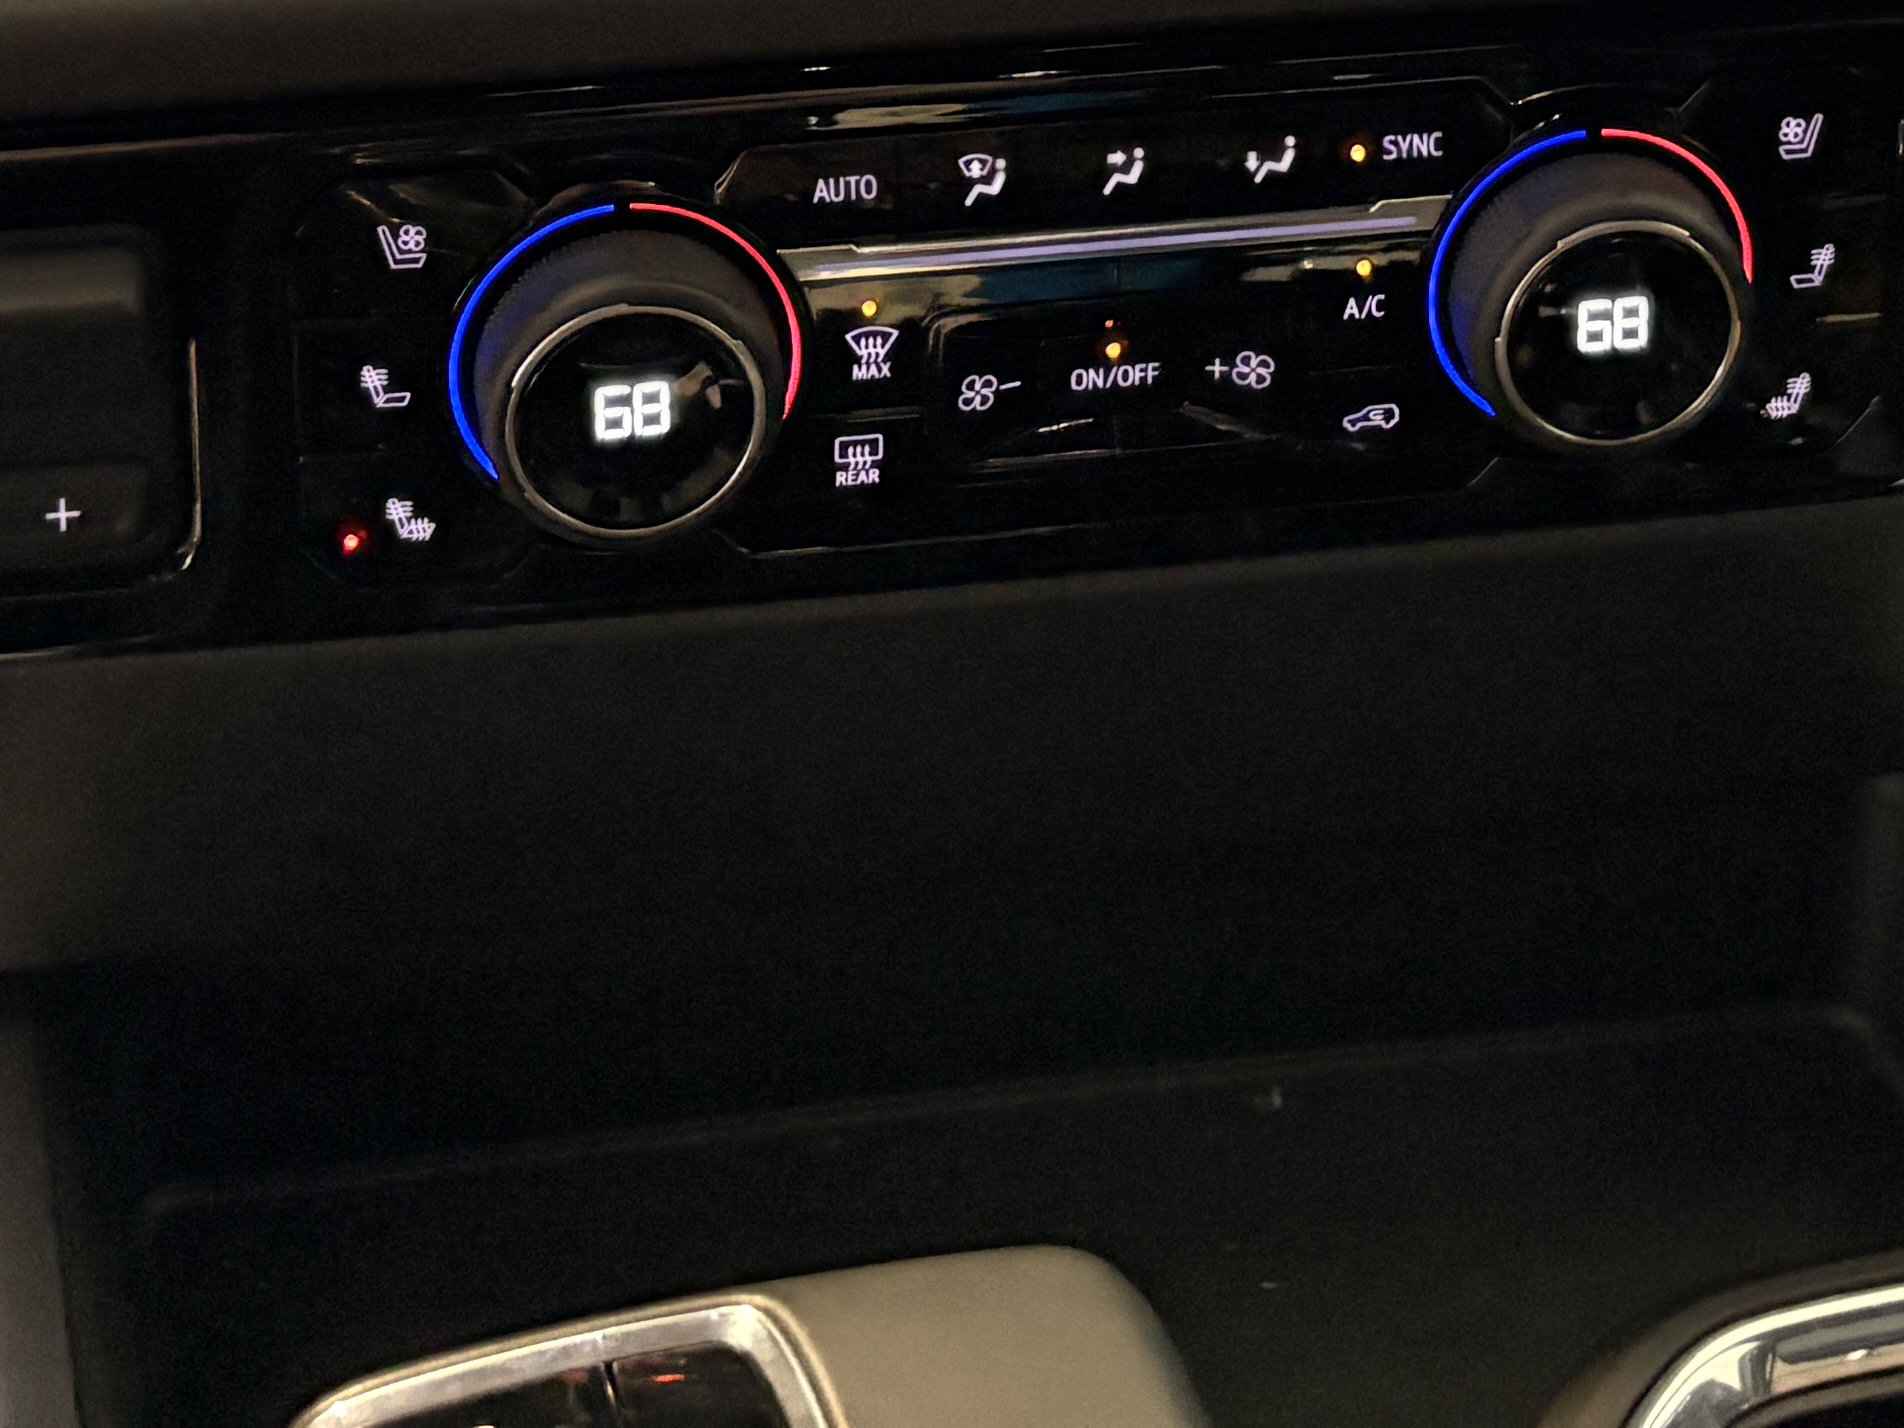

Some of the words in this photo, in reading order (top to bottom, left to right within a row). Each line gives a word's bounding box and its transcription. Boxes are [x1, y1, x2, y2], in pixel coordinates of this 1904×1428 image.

[1382, 133, 1443, 159] SYNC
[812, 175, 878, 204] AUTO
[1343, 294, 1386, 320] A/C
[1576, 295, 1650, 354] 68
[852, 359, 891, 381] MAX
[1070, 362, 1160, 391] ON/OFF
[593, 380, 671, 441] 68
[835, 466, 880, 487] REAR
